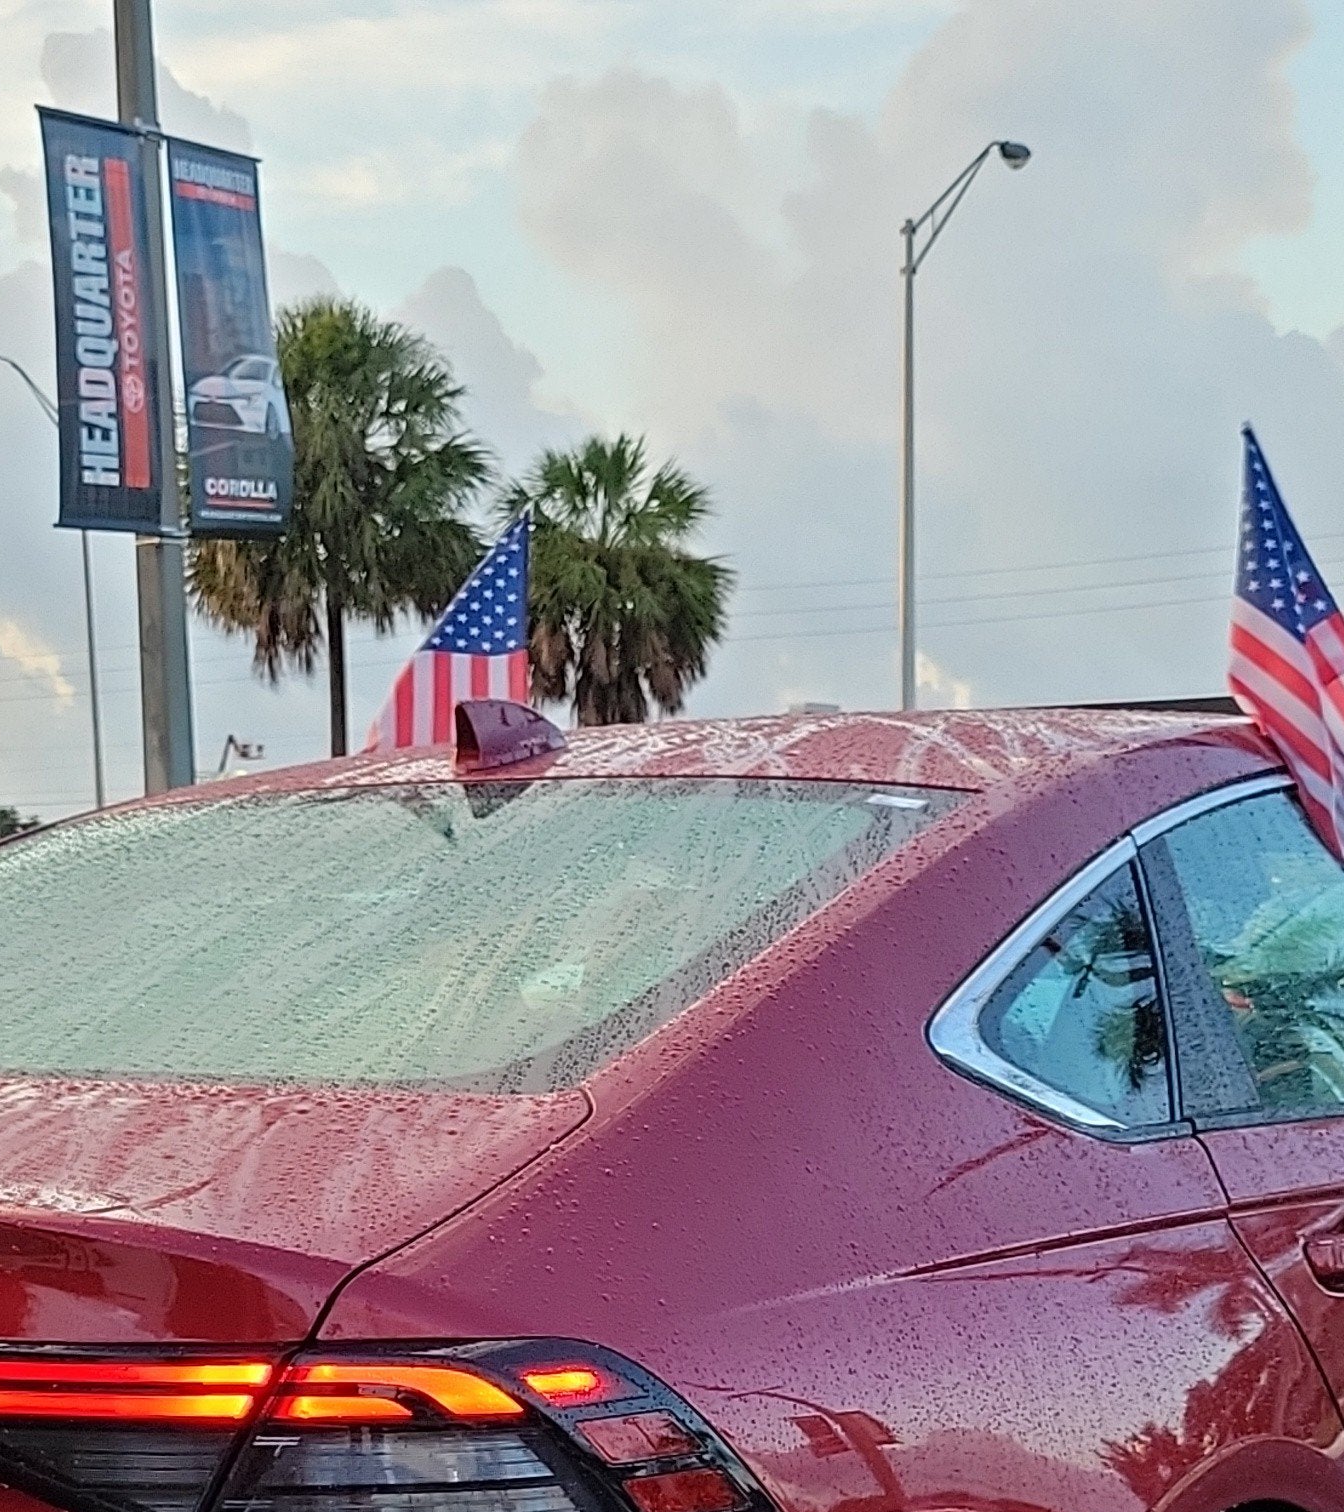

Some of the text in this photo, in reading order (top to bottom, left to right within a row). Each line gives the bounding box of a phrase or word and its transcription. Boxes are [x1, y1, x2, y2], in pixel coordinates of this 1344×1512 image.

[65, 154, 120, 487] HEADQUARTER
[115, 249, 140, 372] TOYOTA
[205, 478, 277, 499] COROLLA
